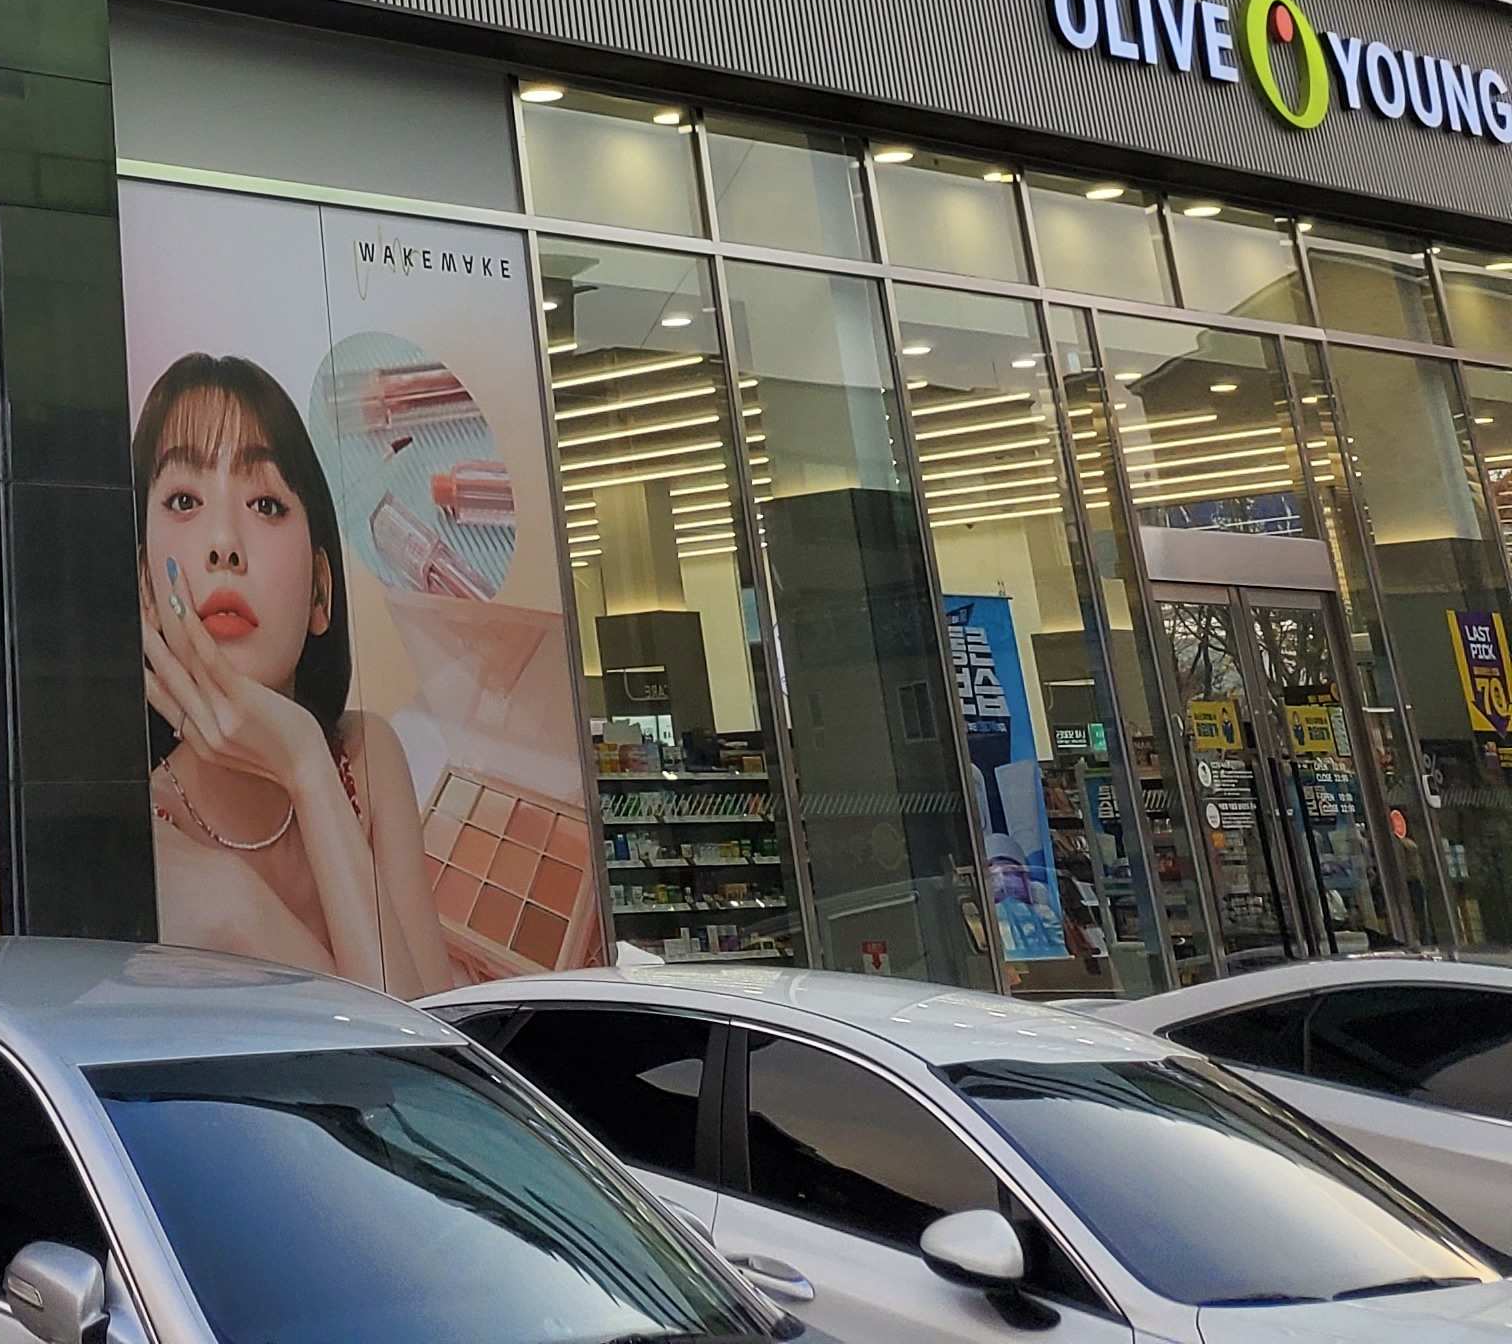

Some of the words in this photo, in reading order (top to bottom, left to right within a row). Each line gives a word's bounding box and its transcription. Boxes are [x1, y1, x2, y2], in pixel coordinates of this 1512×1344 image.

[1324, 30, 1512, 144] YOUNG
[1465, 625, 1490, 642] LAST
[1470, 643, 1496, 660] PICK
